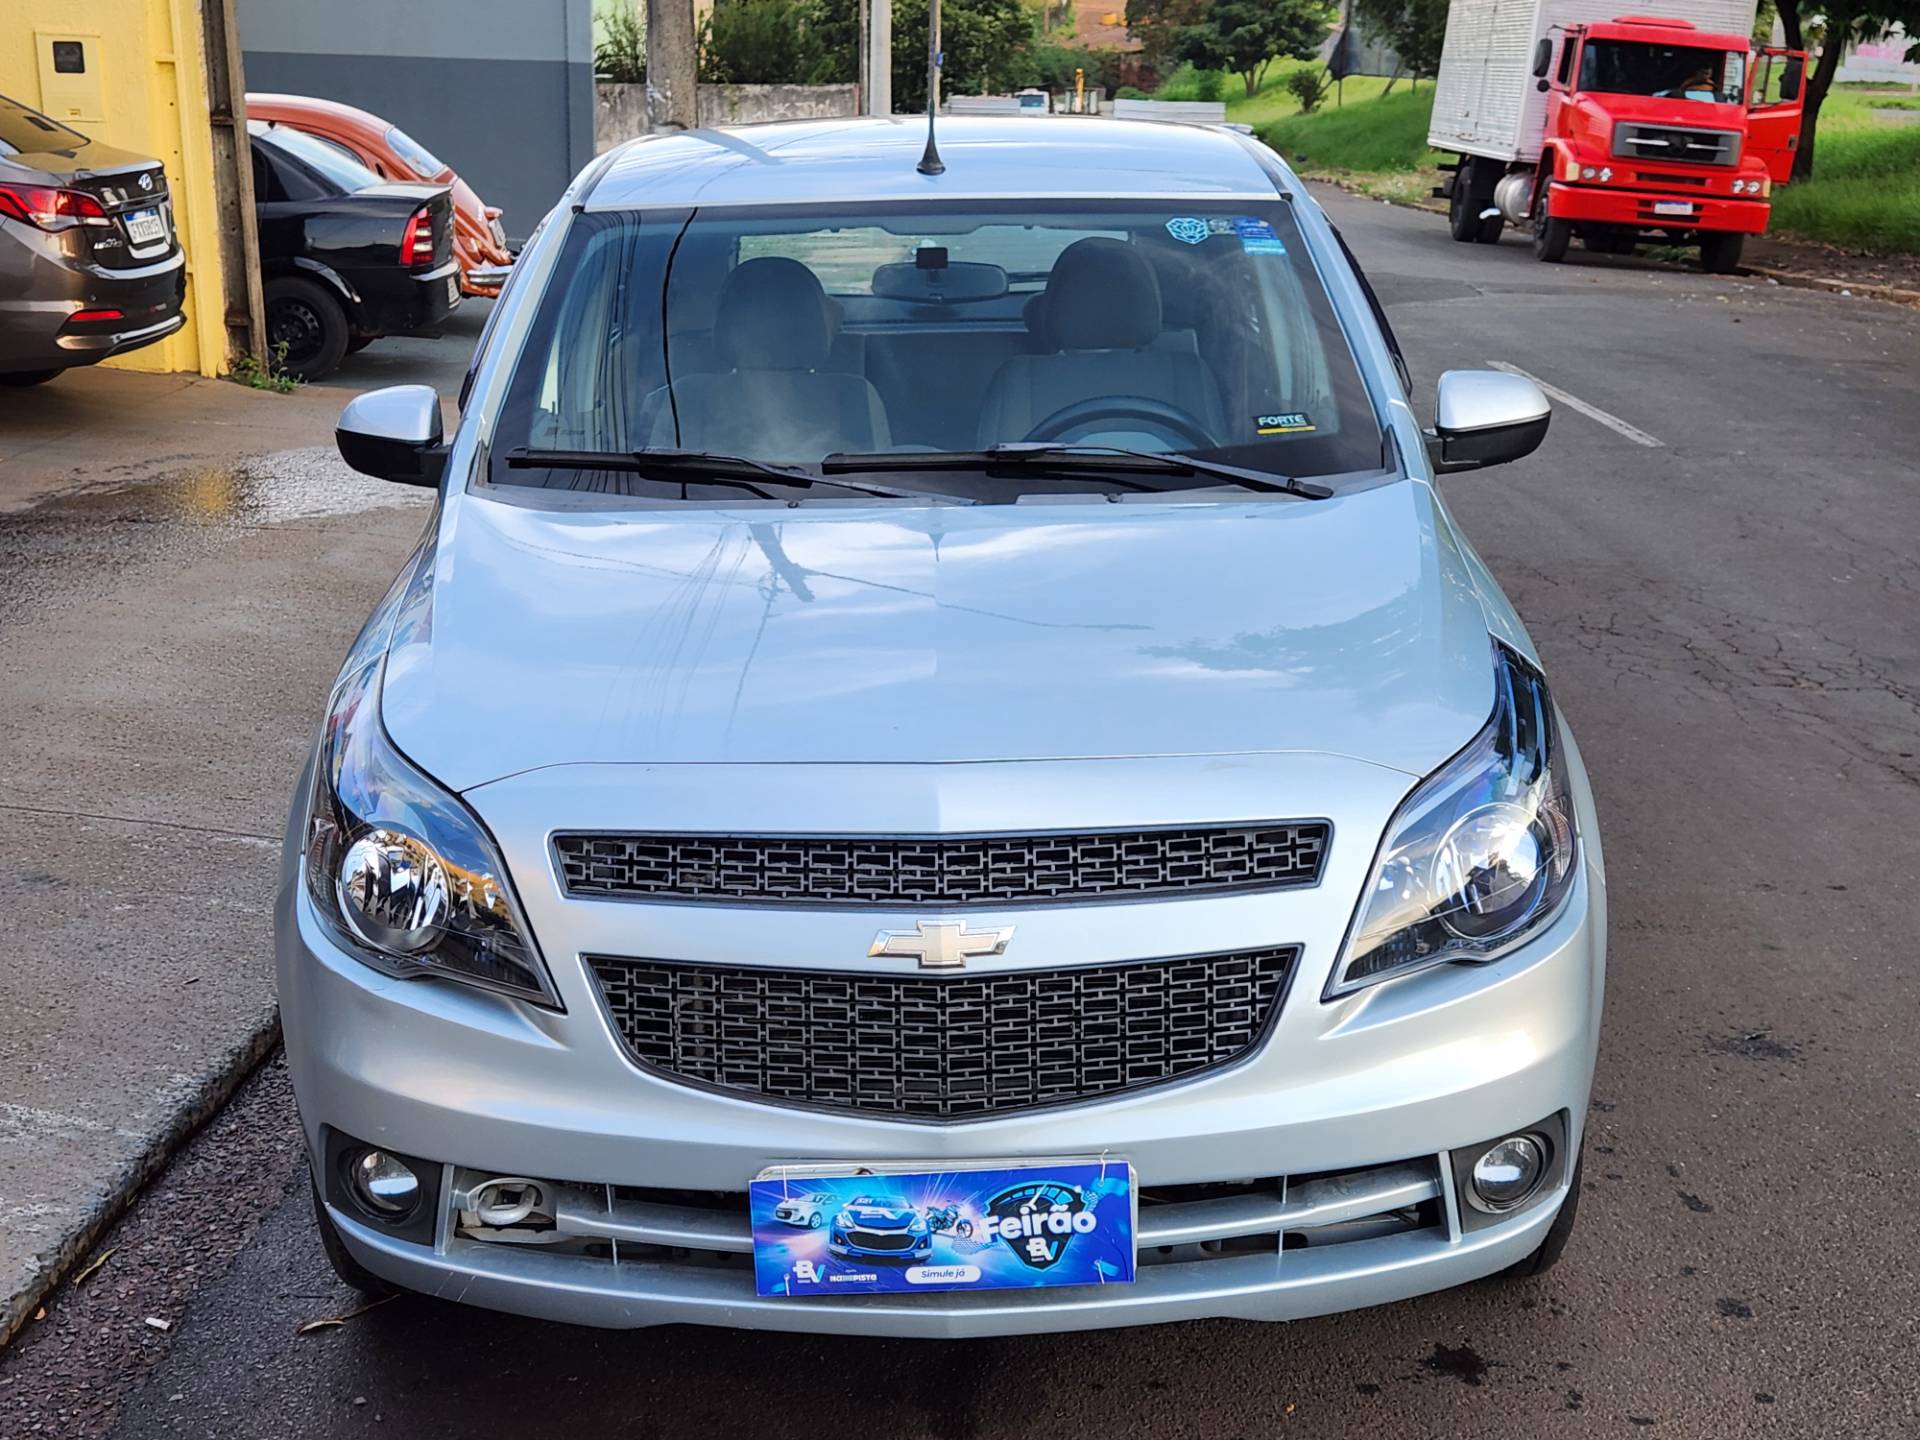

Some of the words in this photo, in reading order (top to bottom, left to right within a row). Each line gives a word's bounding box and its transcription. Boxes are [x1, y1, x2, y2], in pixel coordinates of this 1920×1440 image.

[1258, 414, 1305, 426] FORTE
[979, 1204, 1097, 1243] Feirão
[792, 1260, 826, 1283] BV
[921, 1269, 955, 1278] Simule
